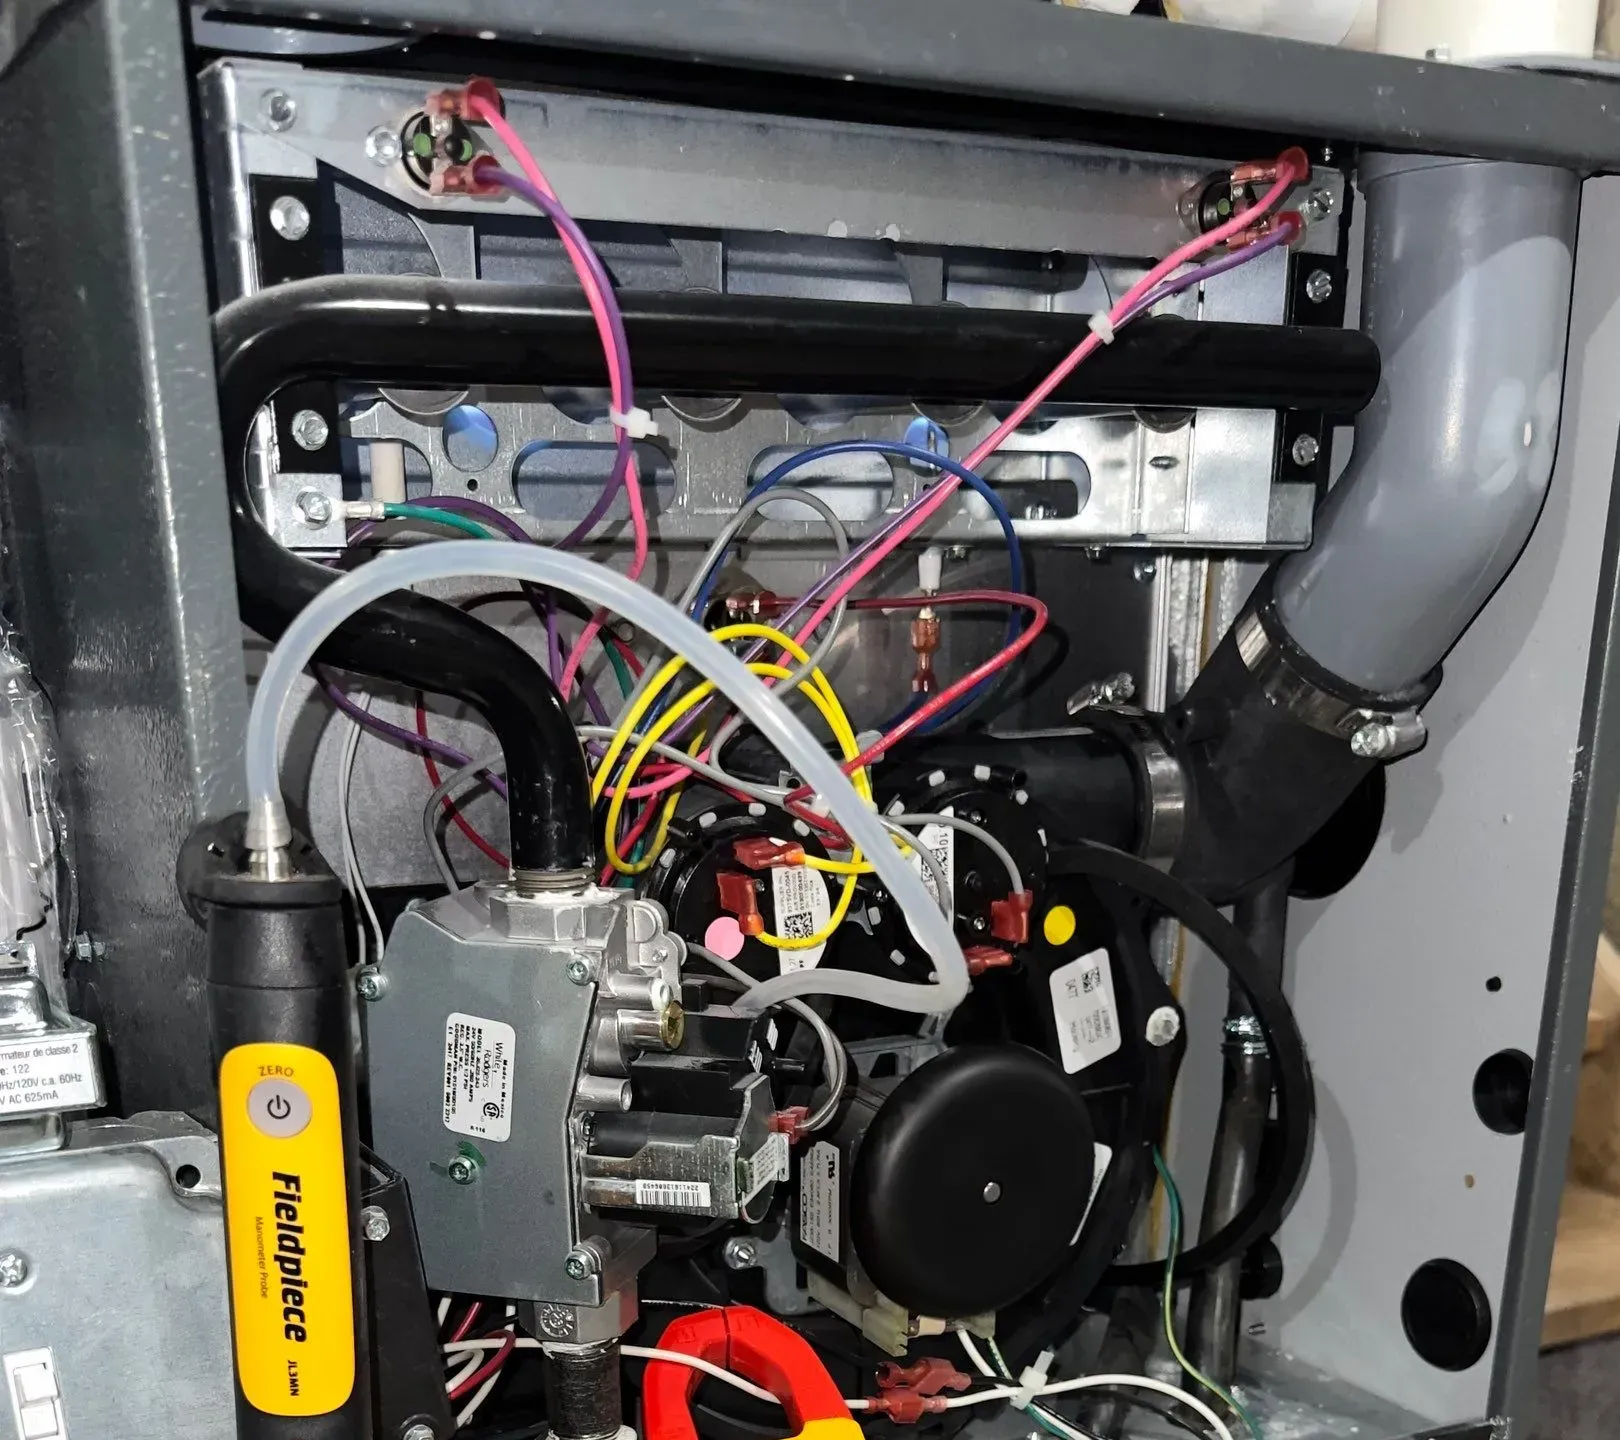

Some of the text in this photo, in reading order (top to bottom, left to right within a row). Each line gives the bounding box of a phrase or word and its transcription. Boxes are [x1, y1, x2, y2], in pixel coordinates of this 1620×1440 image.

[33, 1048, 43, 1057] de
[45, 1045, 71, 1055] classe
[72, 1043, 78, 1053] 2
[494, 1042, 504, 1069] White
[13, 1063, 30, 1074] 122
[59, 1073, 83, 1084] 60Hz
[257, 1065, 294, 1077] ZERO
[483, 1049, 492, 1088] Rodgers
[9, 1094, 22, 1104] AC
[24, 1090, 59, 1102] 625mA
[255, 1216, 268, 1299] Manometer Probe
[272, 1171, 309, 1343] Fieldpiece
[287, 1360, 299, 1396] JL3MN
